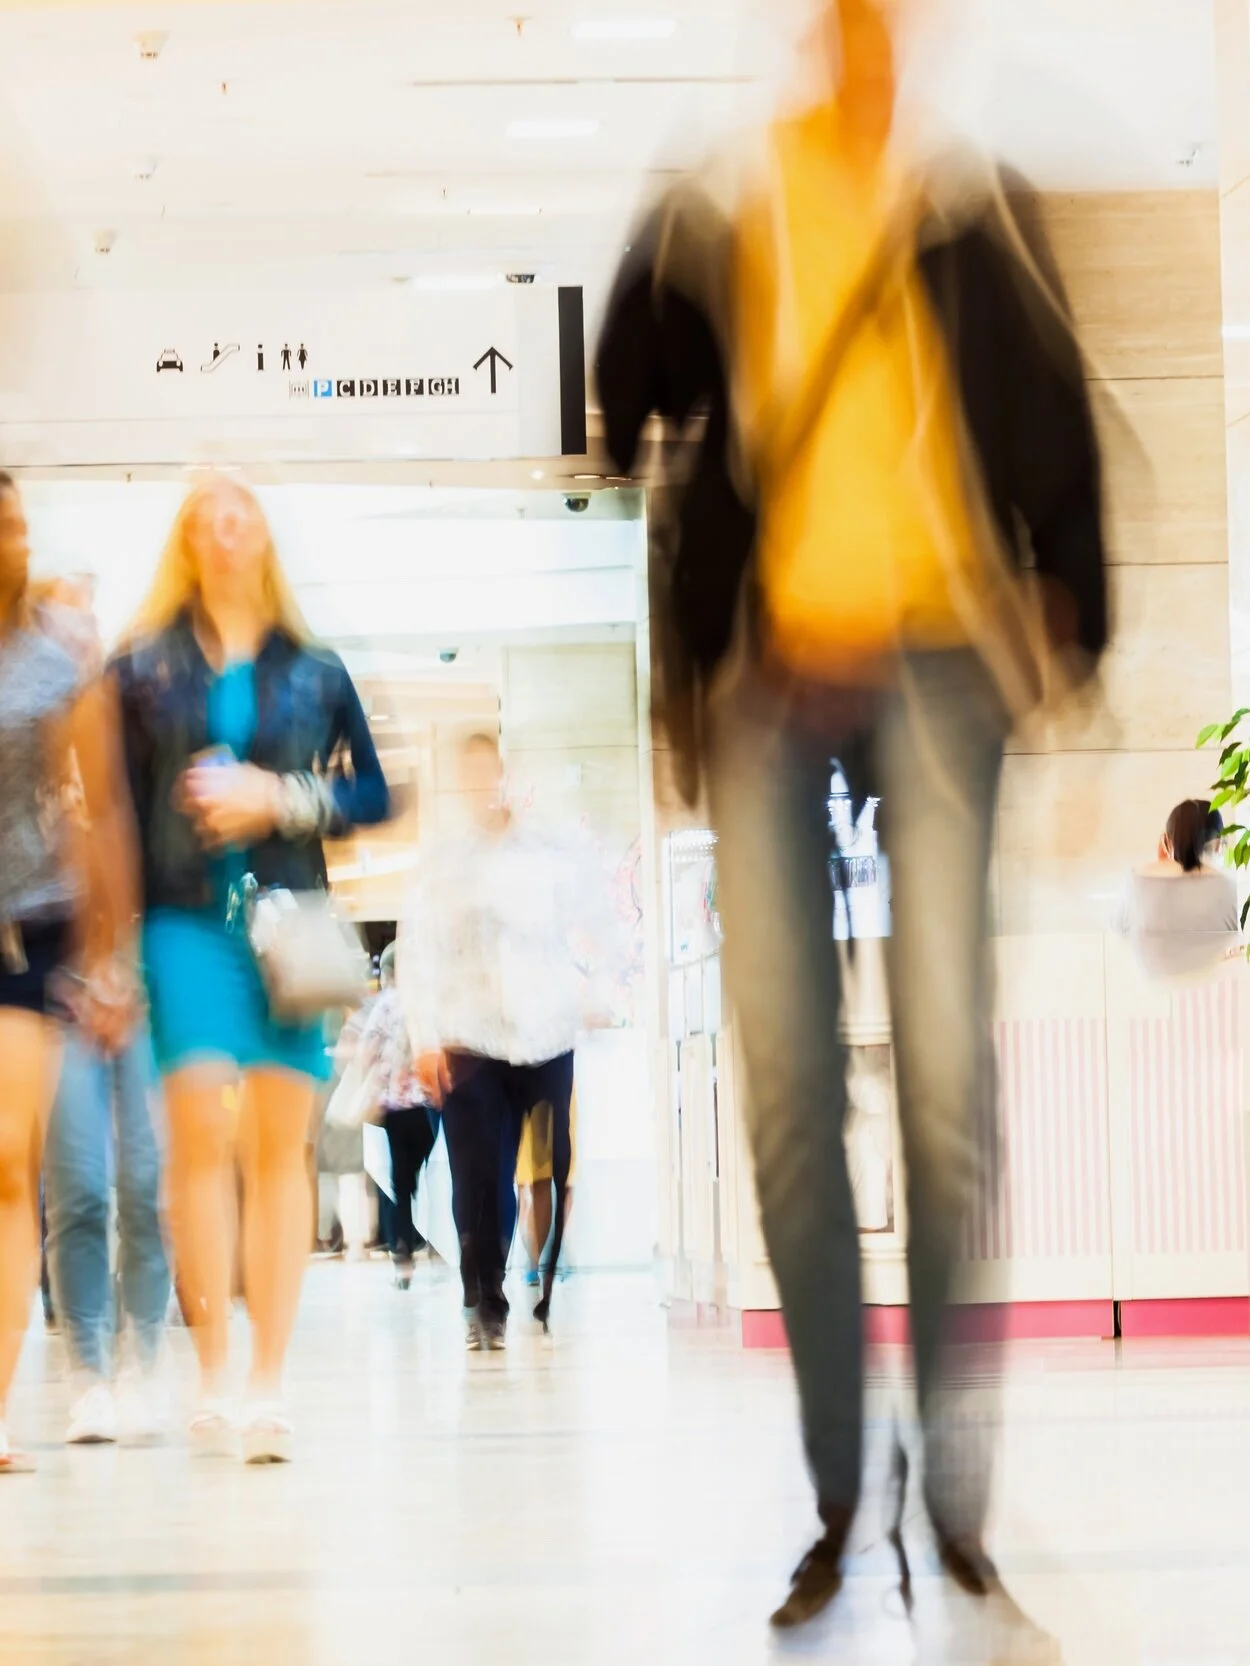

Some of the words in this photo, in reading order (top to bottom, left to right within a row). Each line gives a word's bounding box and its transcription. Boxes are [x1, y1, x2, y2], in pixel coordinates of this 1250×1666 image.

[316, 379, 329, 397] P
[338, 379, 352, 397] C
[361, 379, 375, 397] D
[385, 378, 399, 397] E
[408, 378, 421, 396] F
